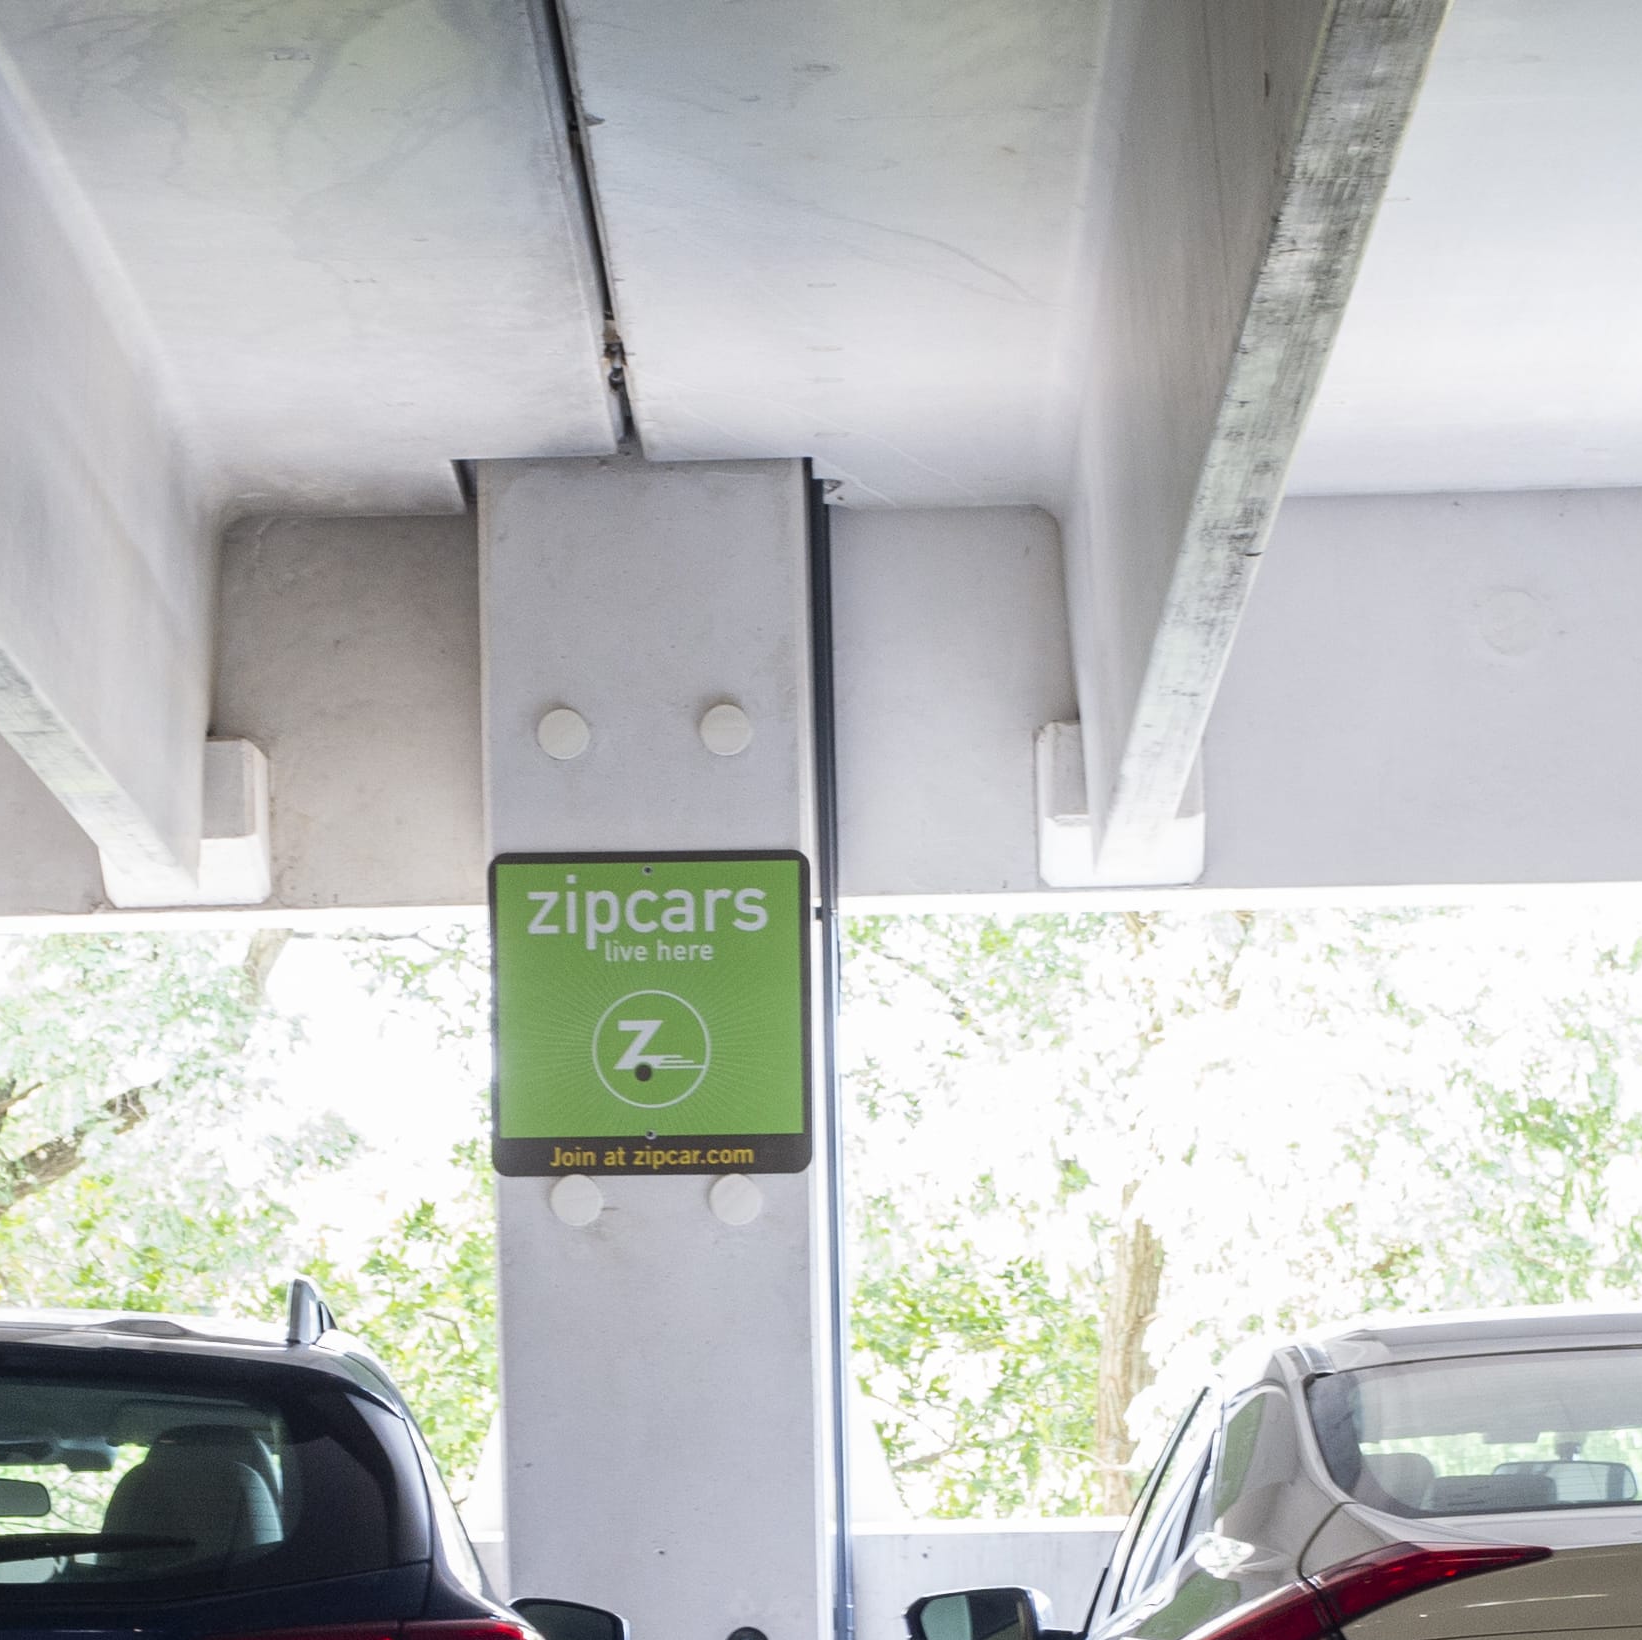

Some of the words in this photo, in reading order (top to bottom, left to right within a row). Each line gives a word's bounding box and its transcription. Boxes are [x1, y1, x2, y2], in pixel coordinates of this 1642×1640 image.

[527, 874, 768, 950] zipcars
[604, 940, 649, 962] live
[656, 939, 714, 961] here
[549, 1147, 597, 1167] Join
[603, 1147, 627, 1166] at
[632, 1145, 755, 1169] zipcar.com
